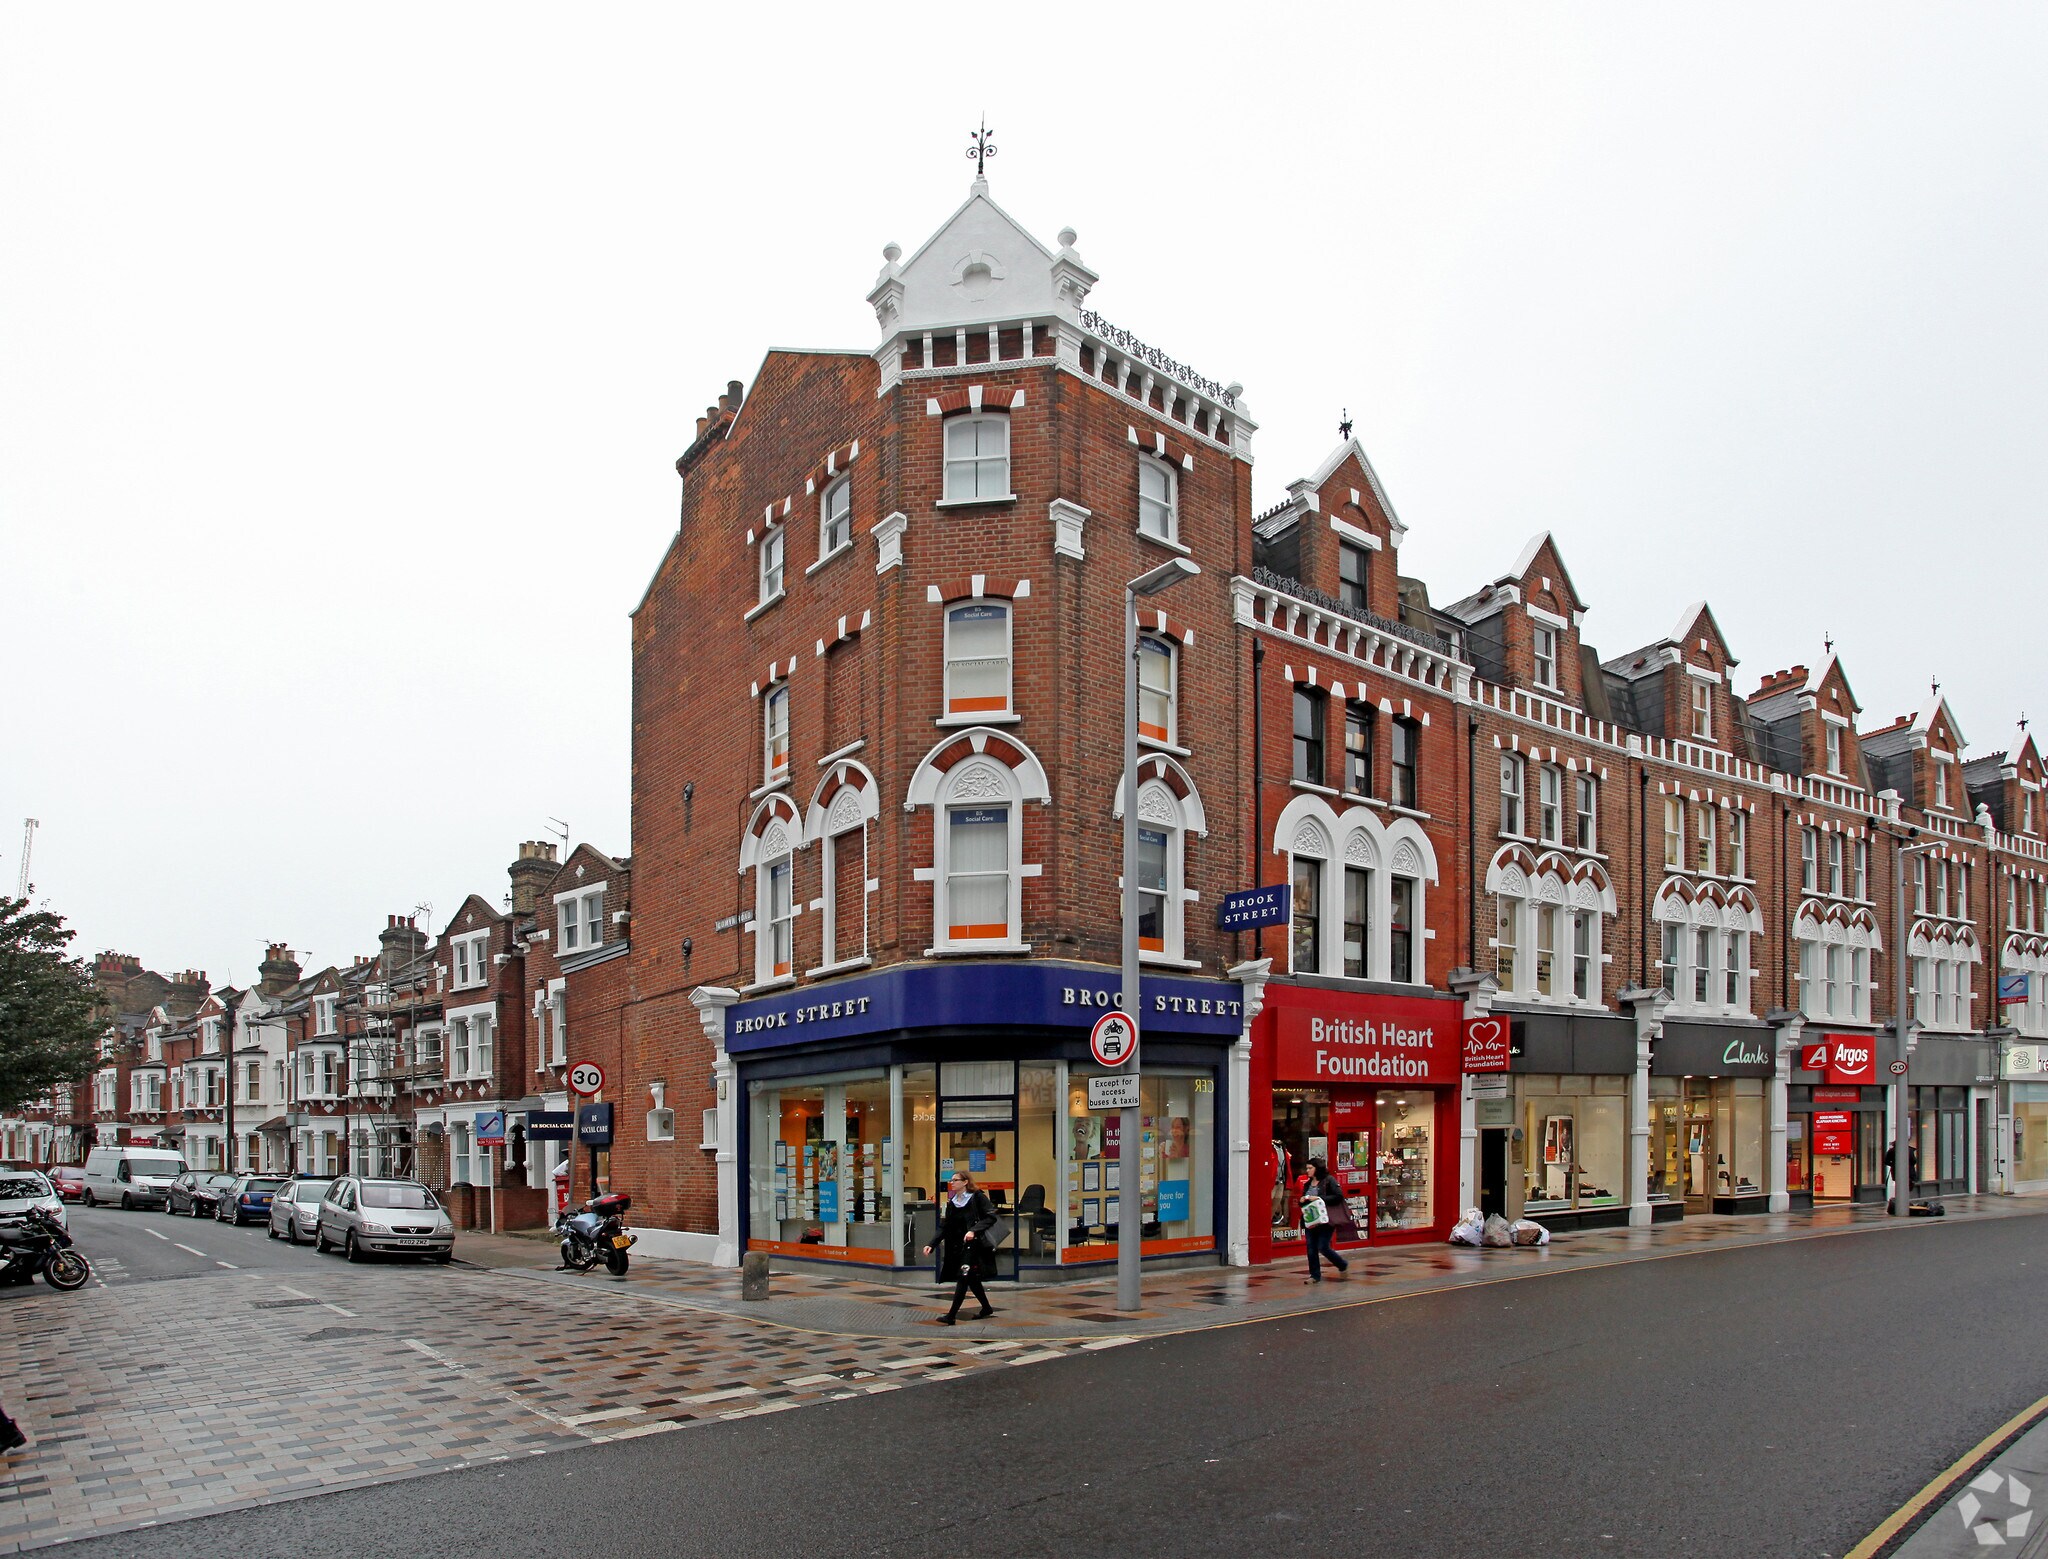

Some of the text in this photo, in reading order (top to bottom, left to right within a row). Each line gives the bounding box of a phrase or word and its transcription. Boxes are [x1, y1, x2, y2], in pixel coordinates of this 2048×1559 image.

[1229, 893, 1274, 909] BROOK
[1224, 907, 1278, 923] STREET
[1063, 987, 1241, 1016] BROO STREET
[735, 996, 871, 1034] BROOK STREET
[1311, 1017, 1434, 1048] British Heart
[1723, 1040, 1769, 1064] Clarks
[1834, 1043, 1868, 1067] Argos
[1316, 1050, 1429, 1077] Foundation
[1464, 1060, 1504, 1068] Foundation
[573, 1070, 600, 1086] 30
[1095, 1078, 1119, 1088] Except
[1101, 1088, 1126, 1096] access
[1089, 1099, 1110, 1107] buses
[1120, 1097, 1138, 1105] taxis
[581, 1125, 608, 1134] SOCIAL CARE
[1106, 1128, 1113, 1136] in
[1159, 1191, 1185, 1199] here for
[1159, 1202, 1171, 1210] you
